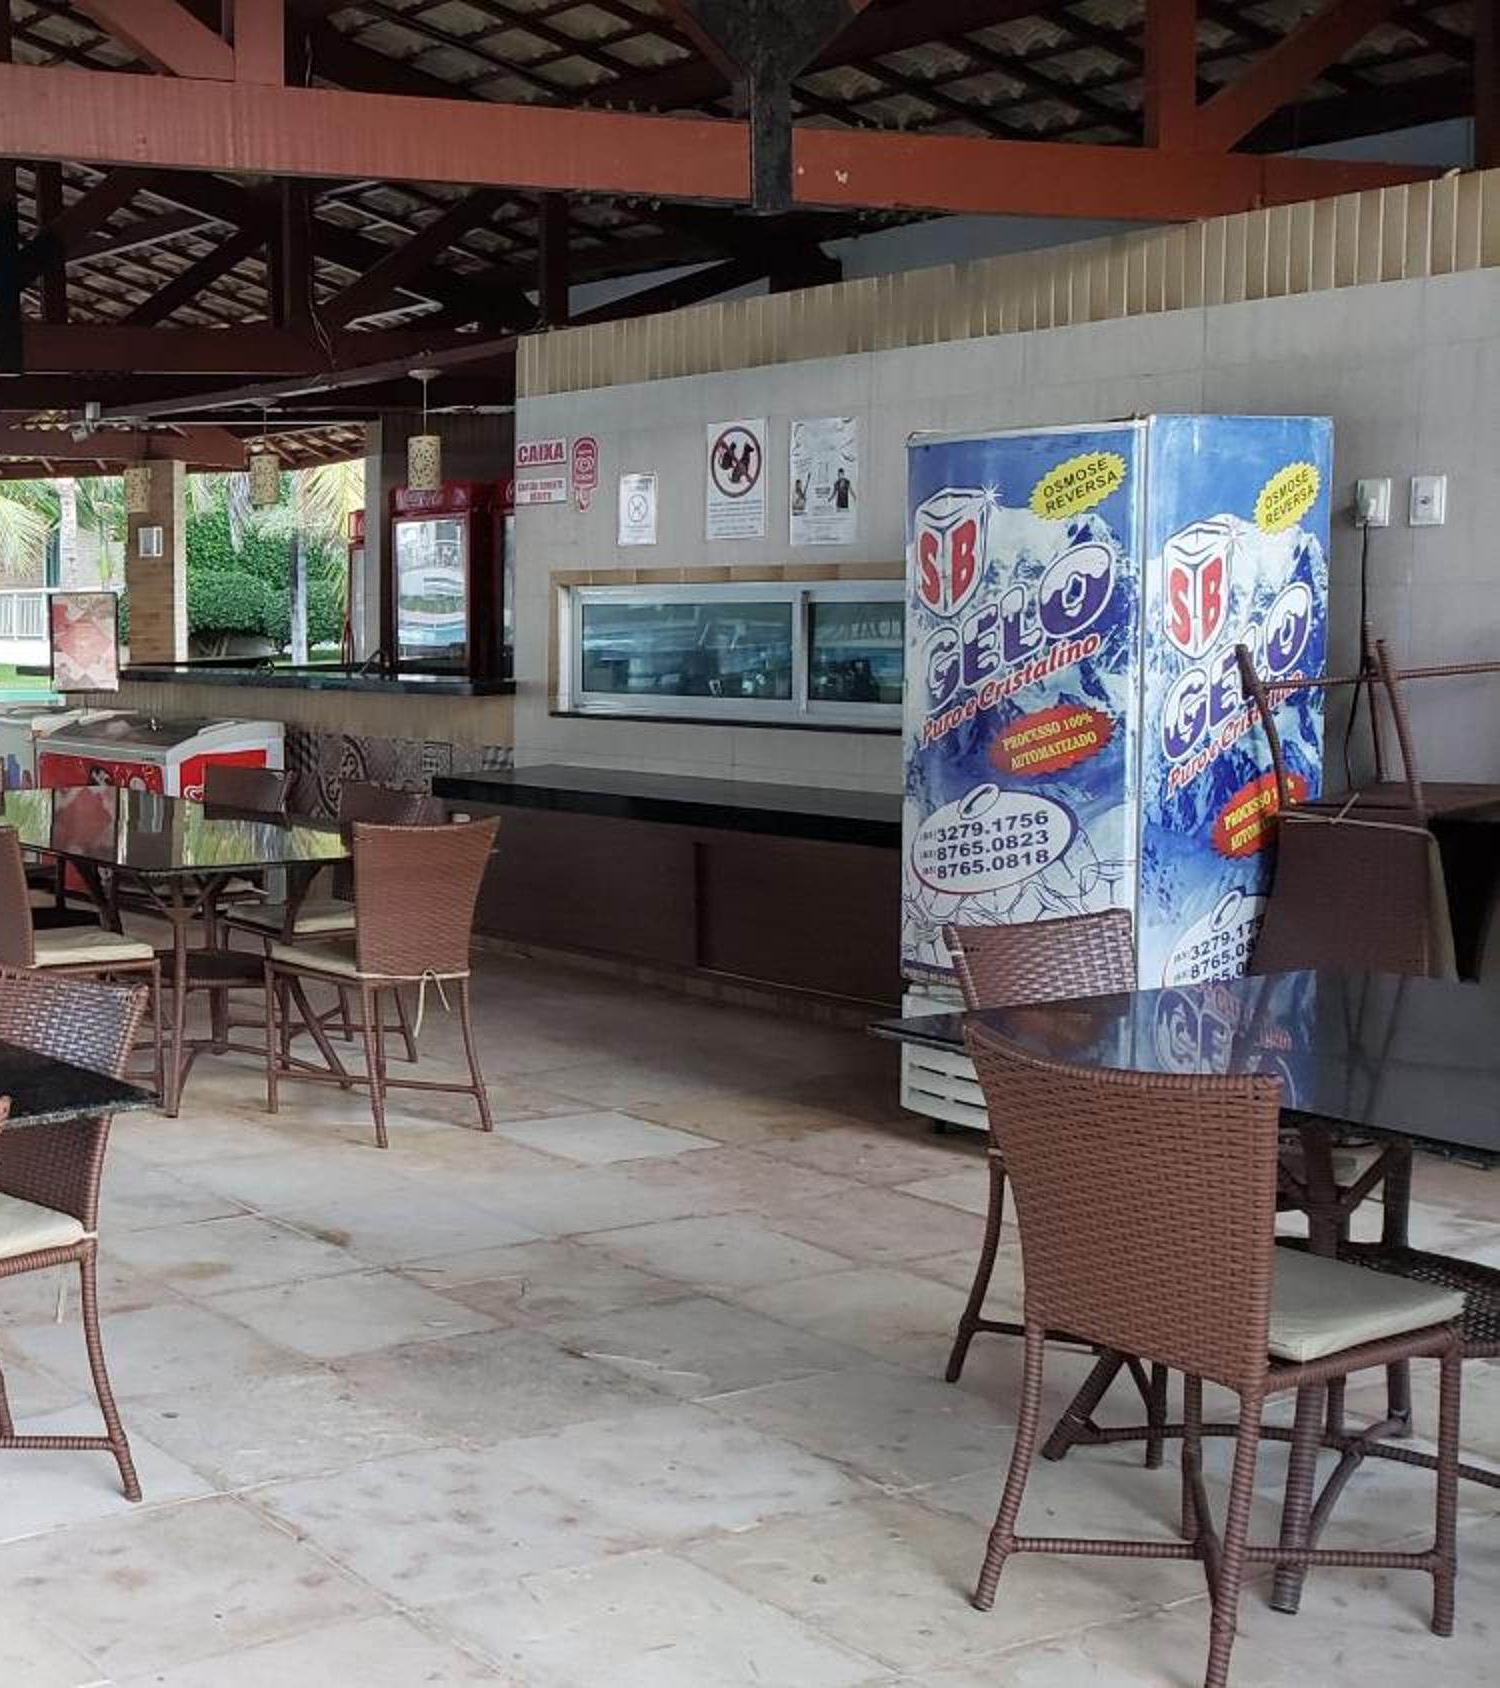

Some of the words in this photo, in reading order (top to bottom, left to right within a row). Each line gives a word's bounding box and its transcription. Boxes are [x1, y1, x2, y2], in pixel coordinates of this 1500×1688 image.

[518, 442, 564, 465] CAIXA
[1042, 456, 1109, 497] OSMOSE
[1045, 470, 1119, 515] REVERSA
[1264, 470, 1309, 507] OSMOSE
[1265, 483, 1315, 525] REVERSA
[920, 518, 977, 606] SB
[1168, 555, 1224, 646] SB
[926, 543, 1115, 710] GELO
[921, 709, 962, 747] Puro
[978, 634, 1100, 710] Cristalino
[1002, 721, 1060, 751] PROCESSO
[1011, 731, 1097, 770] AUTOMATIZADO
[937, 809, 1049, 842] 3279.1756
[937, 829, 1049, 861] 8765.0823
[937, 849, 1049, 879] 8765.0818
